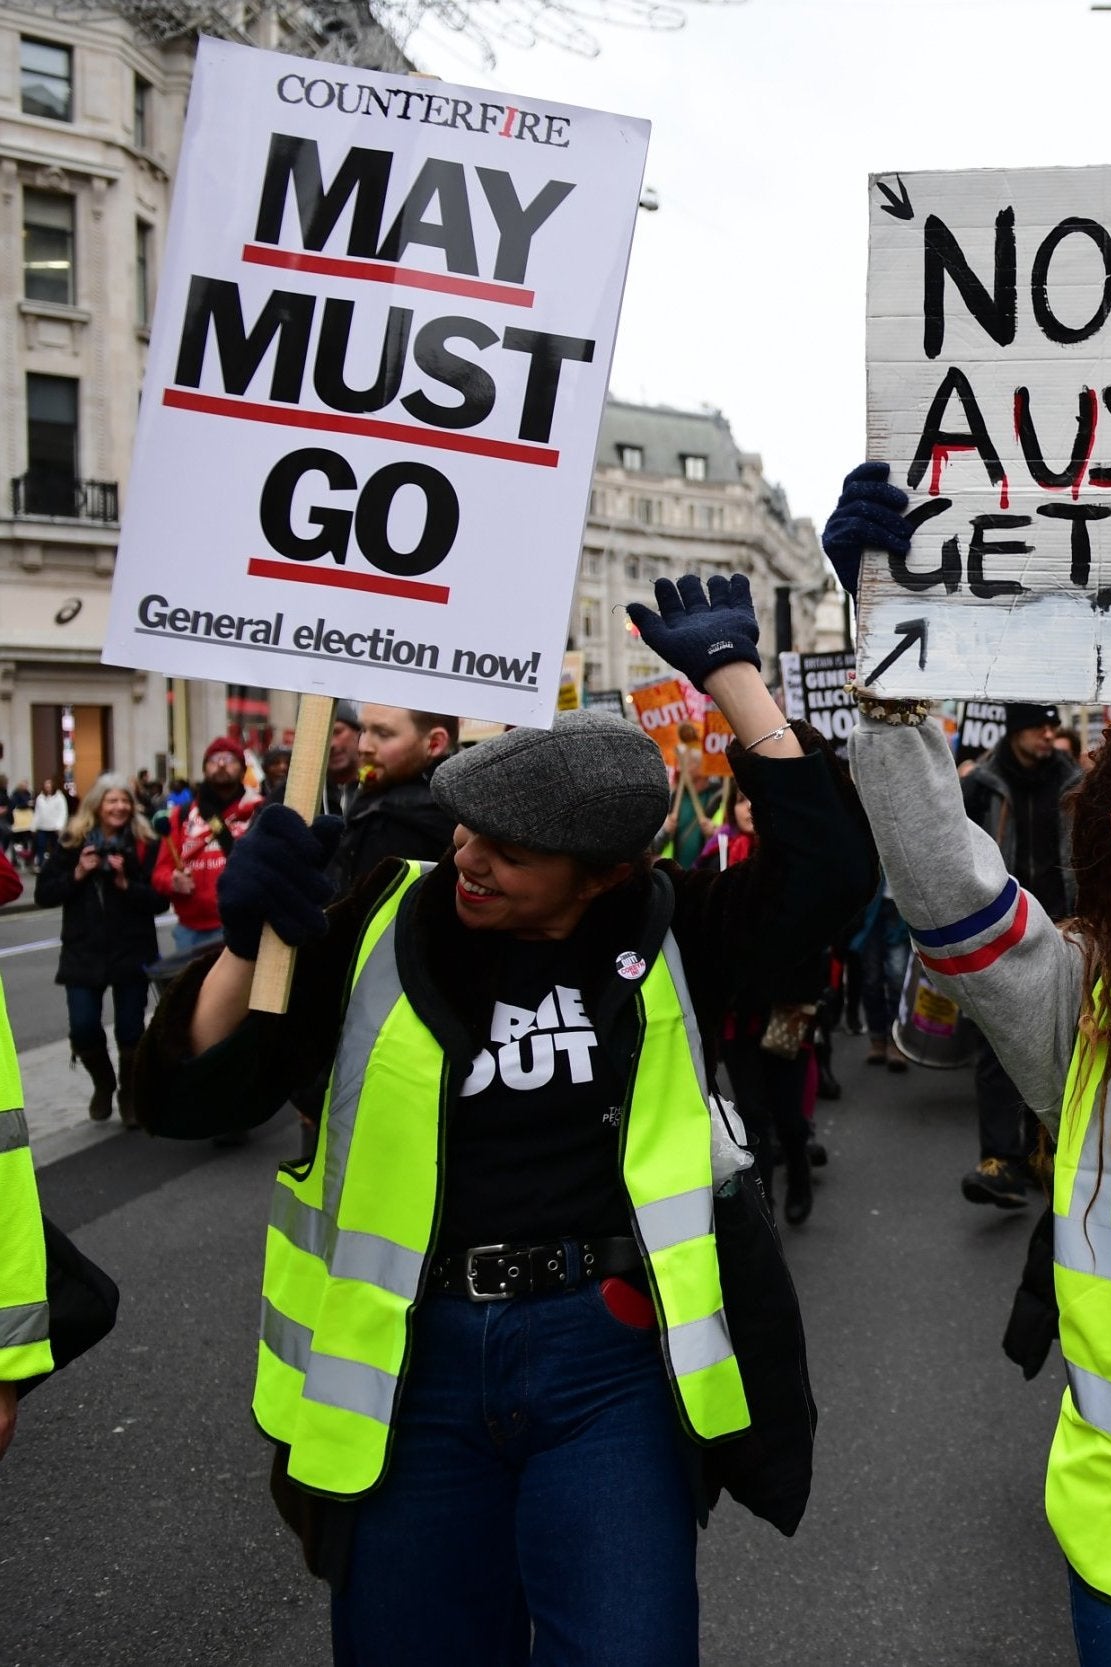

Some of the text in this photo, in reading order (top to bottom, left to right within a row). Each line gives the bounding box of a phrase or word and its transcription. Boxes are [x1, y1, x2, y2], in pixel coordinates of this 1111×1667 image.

[276, 73, 571, 147] COUNTERFIRE
[254, 132, 577, 284] MAY
[174, 274, 597, 443] MUST
[259, 447, 460, 577] GO
[889, 498, 1111, 599] GET
[137, 593, 541, 685] General election now!
[641, 701, 688, 730] OUT!
